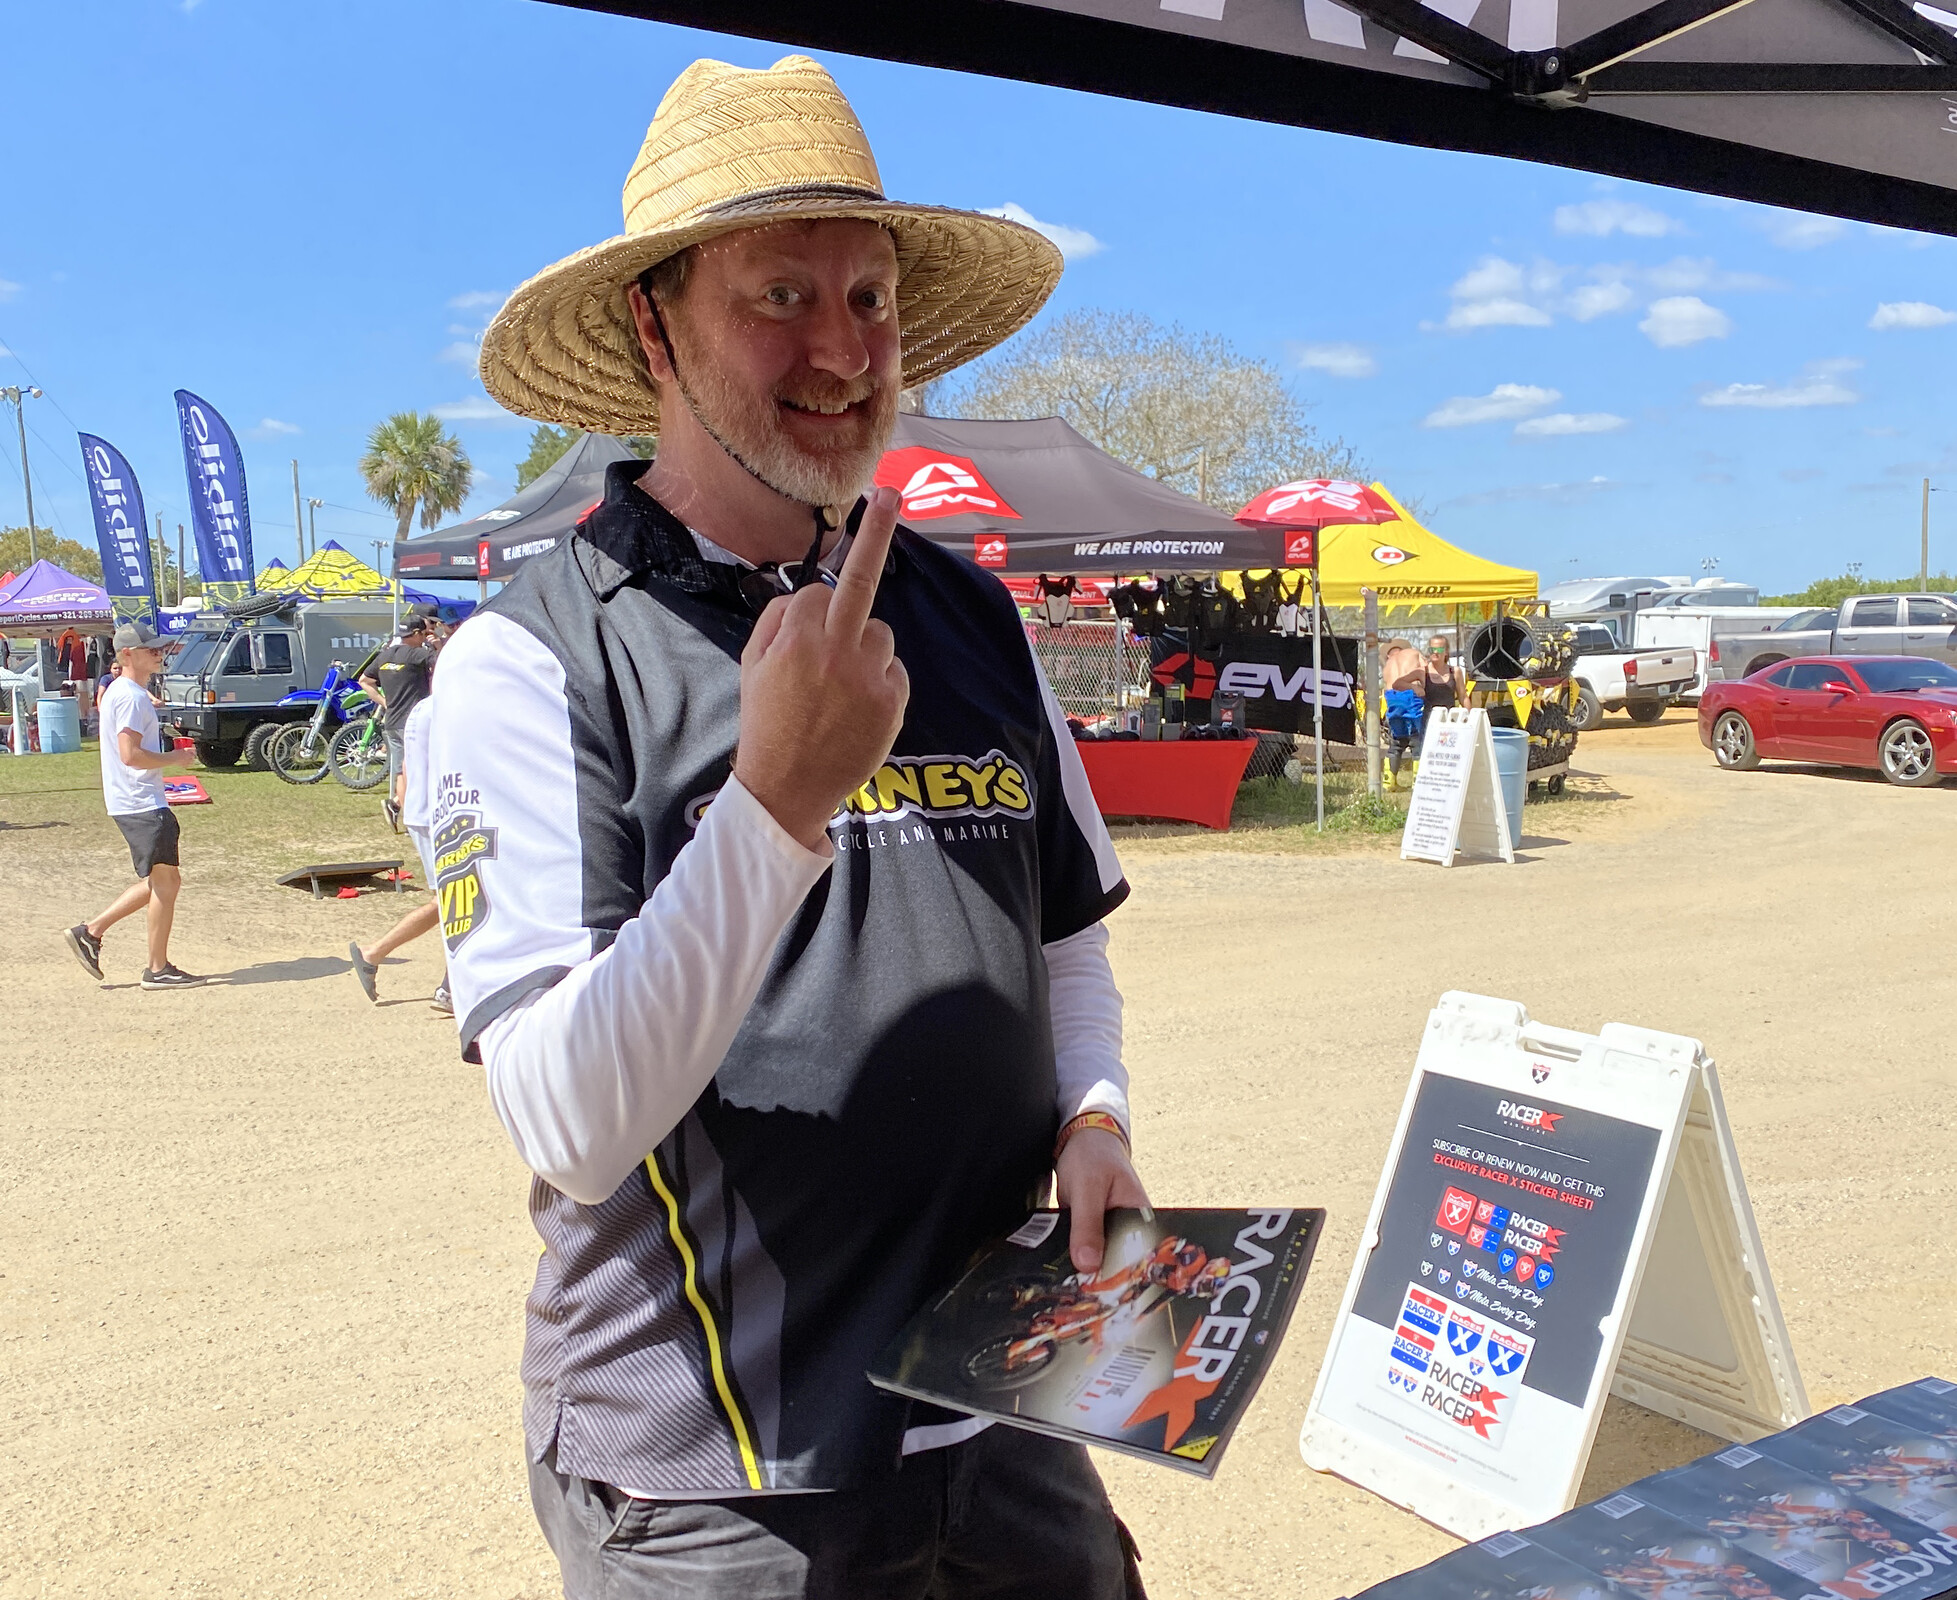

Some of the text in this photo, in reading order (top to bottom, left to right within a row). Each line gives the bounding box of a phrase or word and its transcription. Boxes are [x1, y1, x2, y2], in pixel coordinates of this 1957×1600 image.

[1074, 541, 1224, 556] WE ARE PROTECTION
[1376, 586, 1451, 595] DUNLOP
[448, 790, 480, 808] OUR
[944, 824, 1010, 842] MARINE
[439, 874, 480, 924] VIP
[445, 917, 473, 939] CLUB
[1432, 1138, 1606, 1198] SUBSCRIBE OR RENEW NOW AND GET THIS
[1433, 1153, 1594, 1211] EXCLUSIVE RACER X STICKER SHEET!
[1522, 1288, 1544, 1308] Day.
[1406, 1299, 1444, 1325] RACER X
[1451, 1313, 1483, 1333] RACER
[1514, 1310, 1537, 1330] Day.
[1394, 1336, 1432, 1362] RACER X
[1450, 1326, 1474, 1352] X
[1492, 1332, 1526, 1354] RACER
[1491, 1344, 1515, 1372] X
